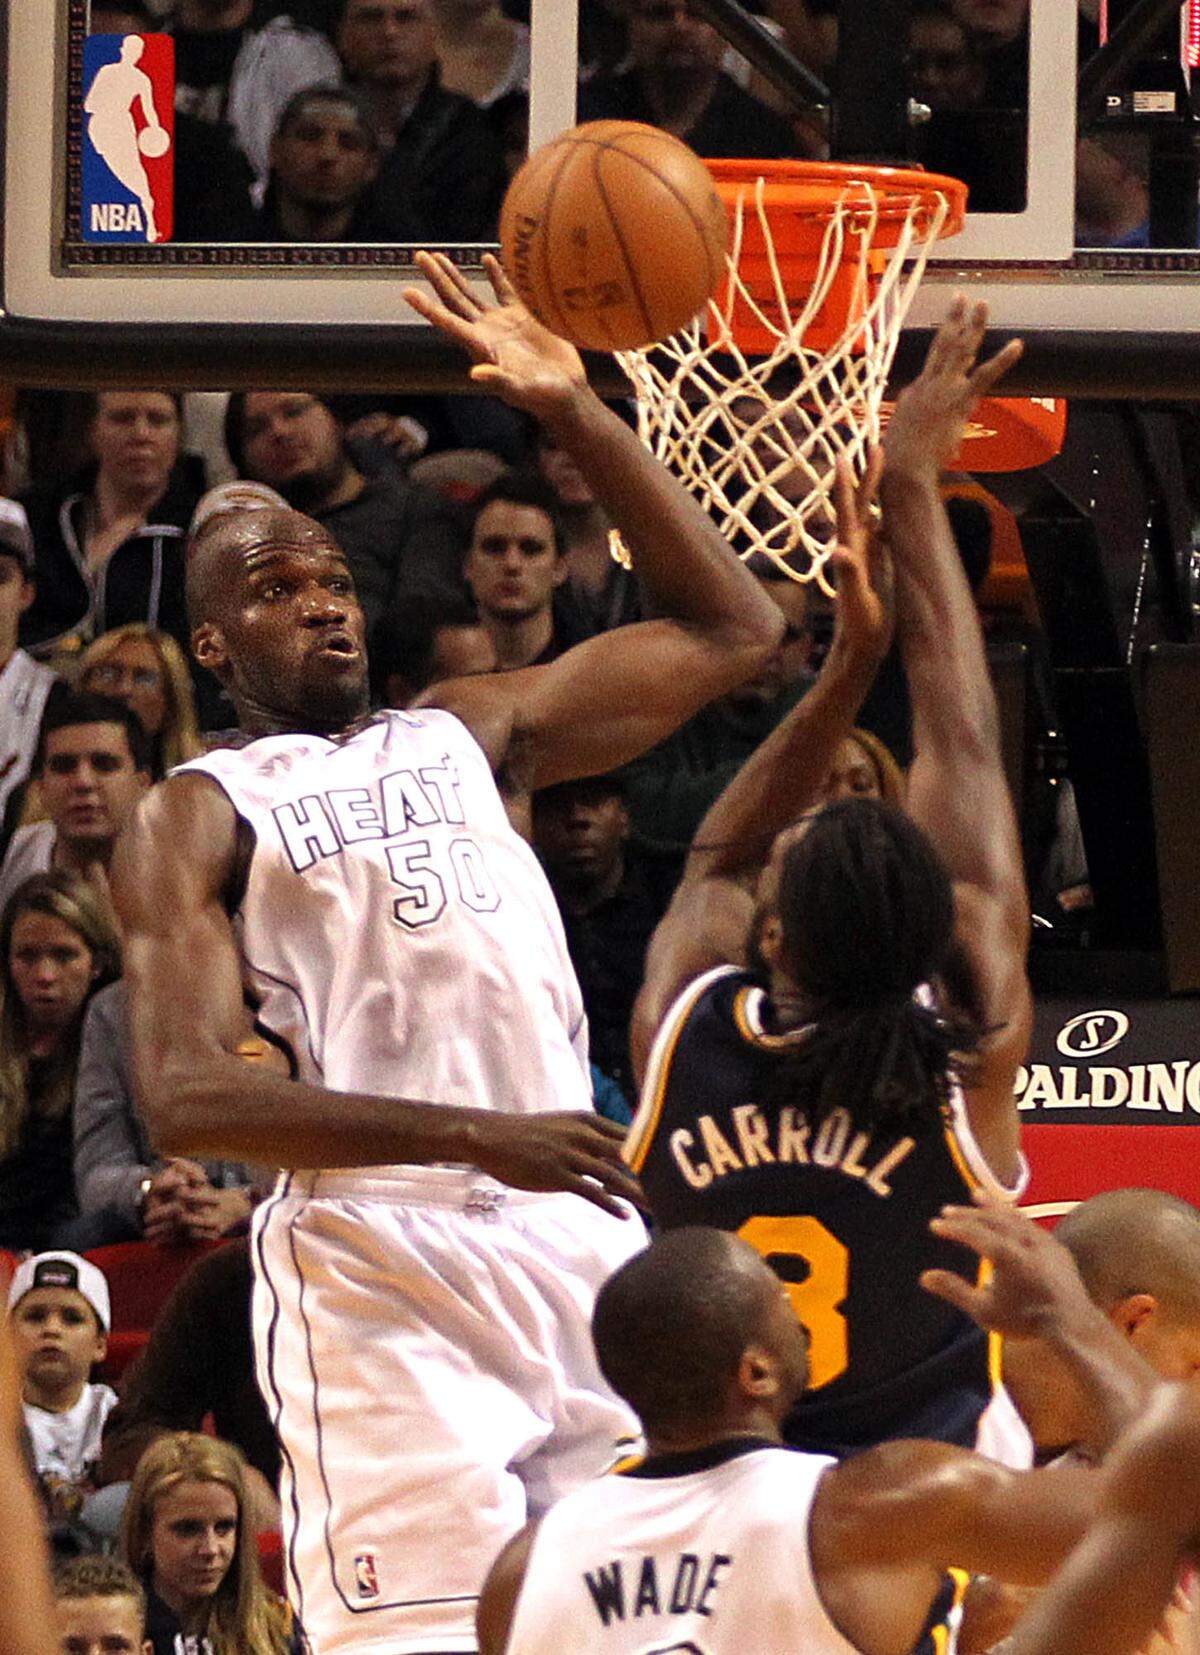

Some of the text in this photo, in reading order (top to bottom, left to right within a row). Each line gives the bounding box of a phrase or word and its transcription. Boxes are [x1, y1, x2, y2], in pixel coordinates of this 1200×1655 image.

[91, 203, 143, 232] NBA
[272, 754, 465, 874] HEAT
[385, 839, 501, 928] 50
[670, 1103, 916, 1197] CARROLL
[583, 1552, 733, 1626] WADE
